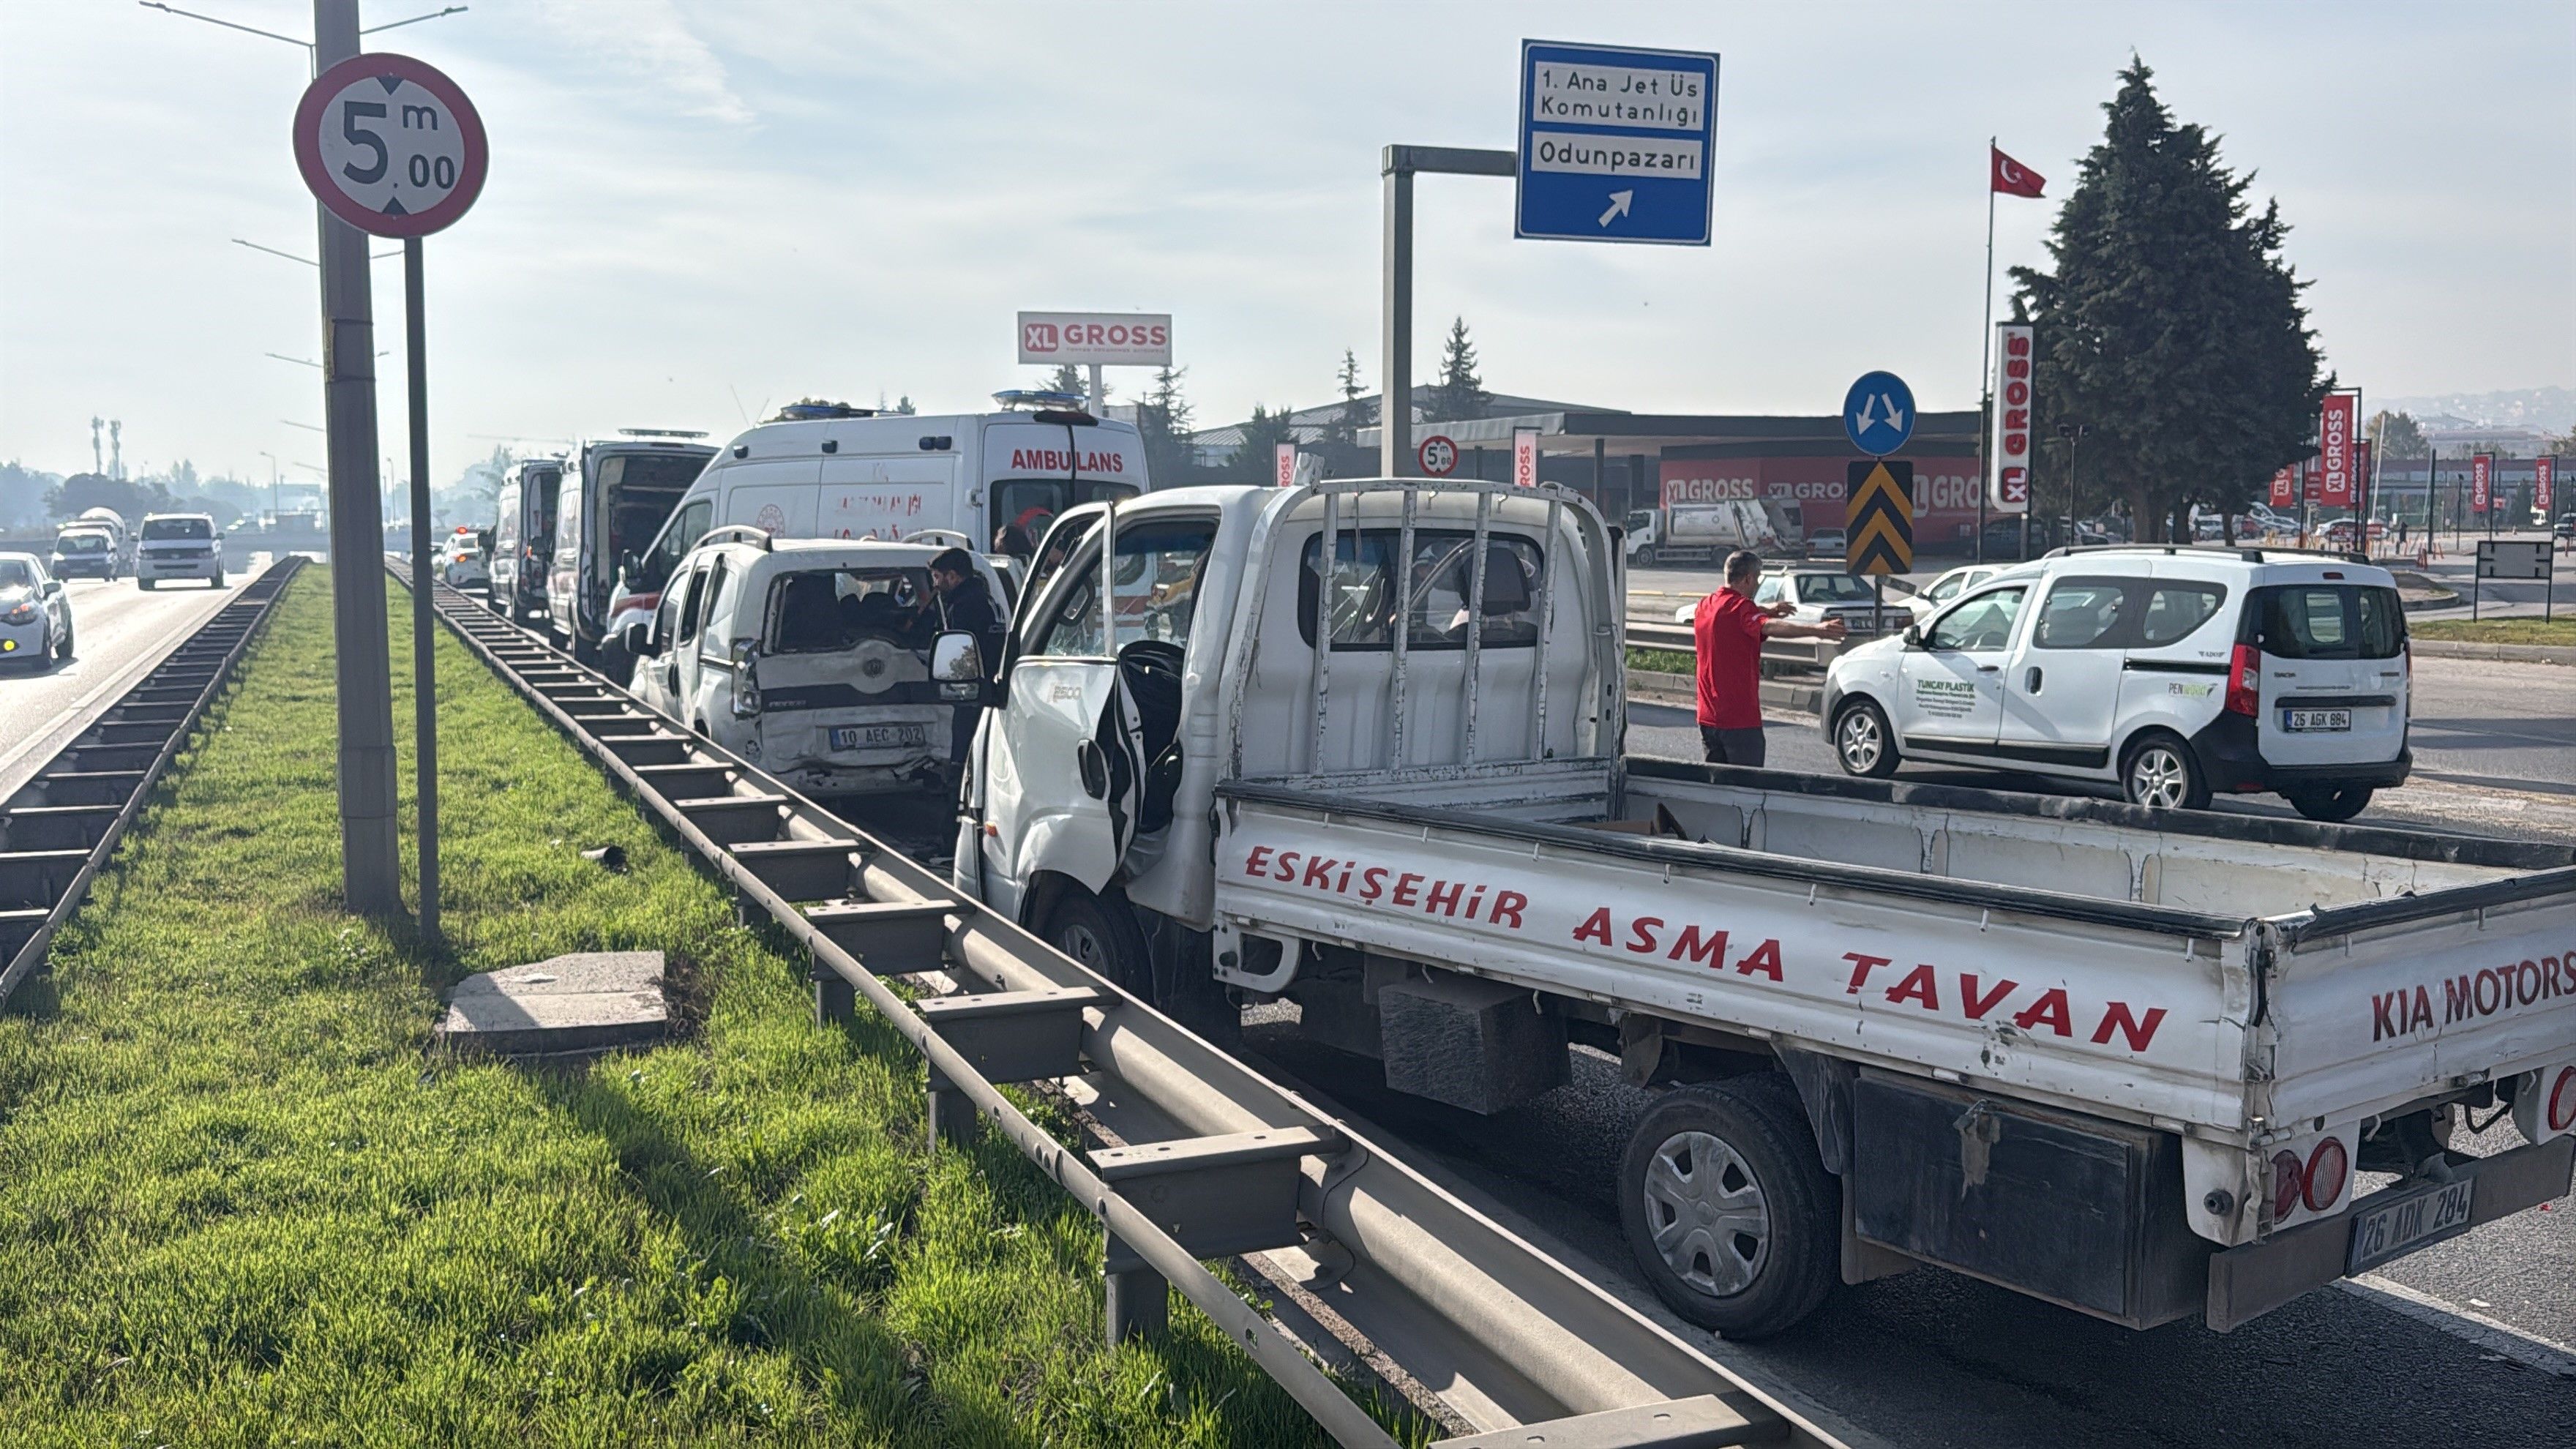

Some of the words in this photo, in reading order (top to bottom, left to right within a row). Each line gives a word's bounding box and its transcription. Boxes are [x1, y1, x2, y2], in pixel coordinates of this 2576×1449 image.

[1543, 70, 1558, 89] 1.
[1566, 71, 1607, 91] Ana
[1620, 75, 1658, 95] Jet
[1670, 73, 1698, 97] Üs
[1541, 95, 1697, 127] Komutanlığı
[342, 100, 389, 184] 5
[402, 105, 438, 130] m
[1540, 141, 1694, 172] Odunpazarı
[408, 154, 455, 190] 00
[1027, 326, 1057, 350] XL
[1064, 323, 1167, 346] GROSS
[2004, 337, 2029, 456] GROSS
[2326, 408, 2343, 471] GROSS
[1011, 449, 1123, 473] AMBULANS
[1427, 446, 1439, 465] 5
[1688, 478, 1753, 501] GROSS
[1794, 482, 1847, 500] GRO
[2006, 468, 2026, 501] XL
[2326, 472, 2345, 493] XL
[2294, 713, 2306, 726] 26
[841, 731, 857, 744] 10
[1572, 906, 1784, 982] ASMA
[1841, 951, 2168, 1052] TAVAN
[2372, 984, 2434, 1043] KIA
[2444, 951, 2576, 1025] MOTORS
[2362, 1213, 2388, 1259] 26
[2390, 1197, 2428, 1245] ADK
